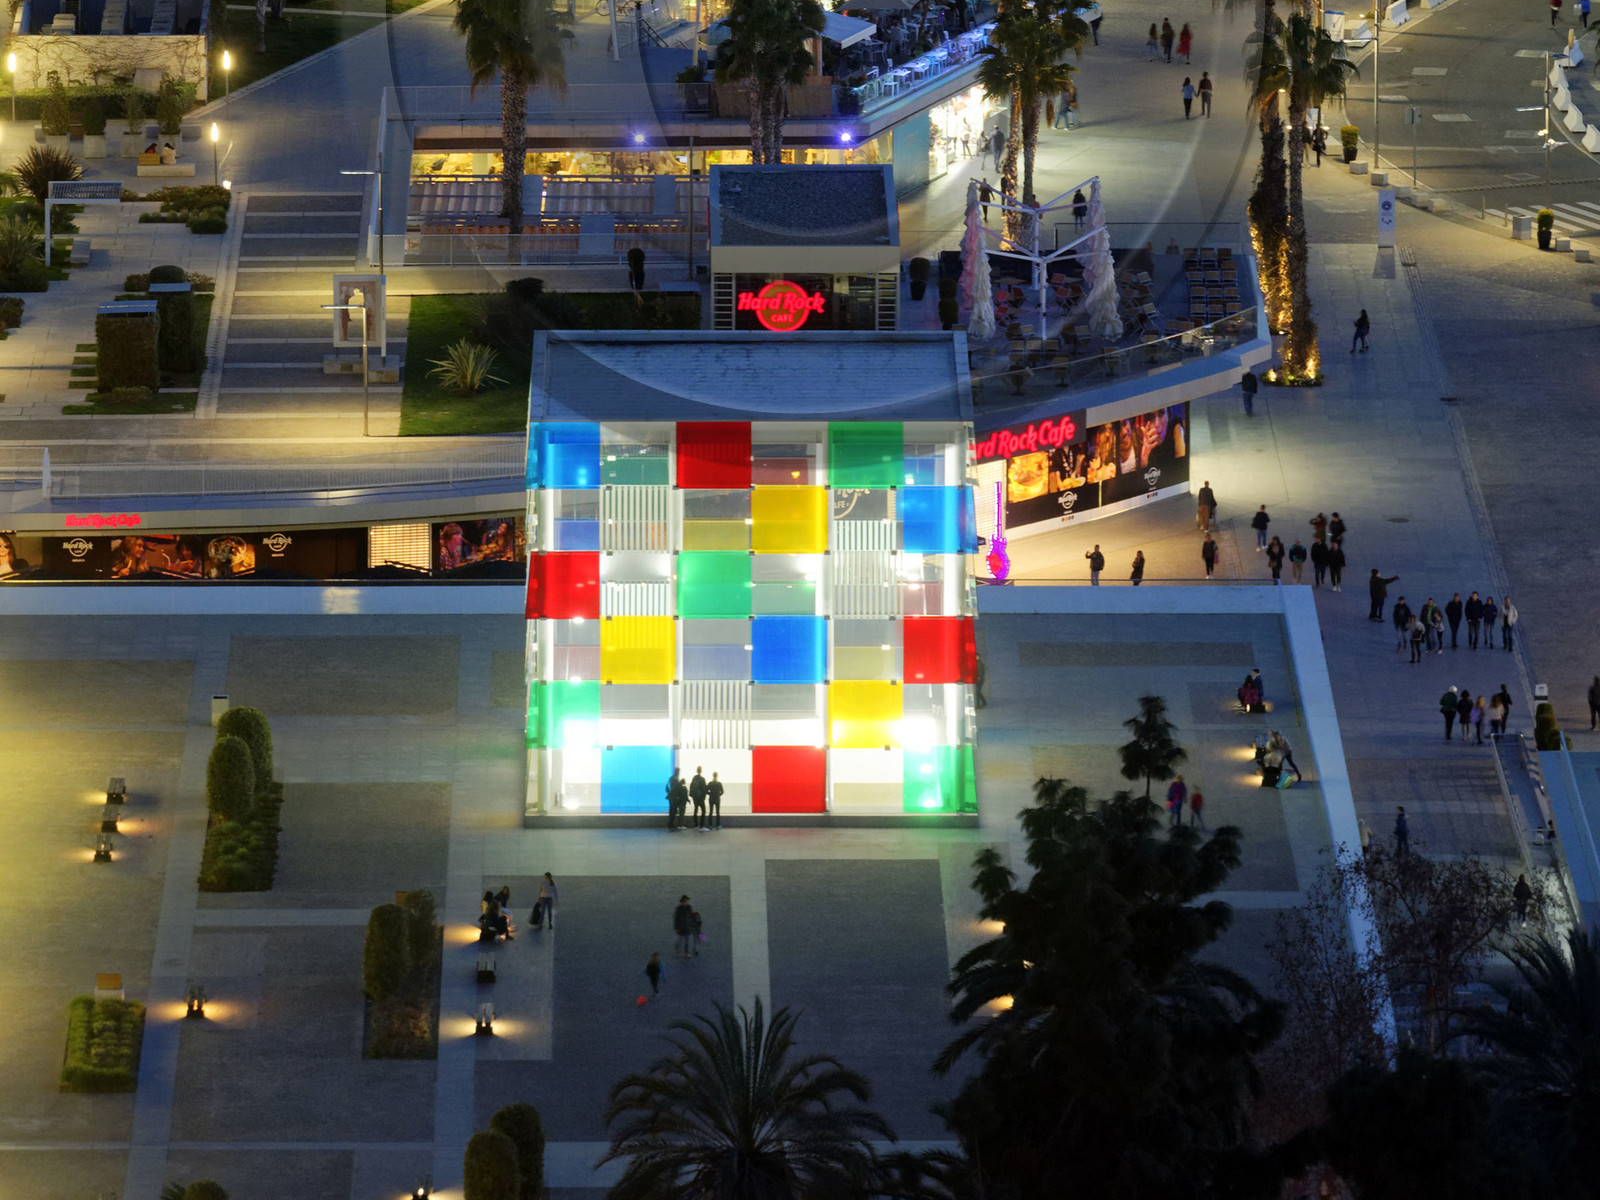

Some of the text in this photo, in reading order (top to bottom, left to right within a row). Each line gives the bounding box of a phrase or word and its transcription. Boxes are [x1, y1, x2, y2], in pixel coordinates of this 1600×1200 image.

[737, 292, 825, 314] Hard Rock
[770, 314, 794, 323] CAFE
[996, 424, 1038, 459] Rock
[1038, 416, 1076, 448] Cafe
